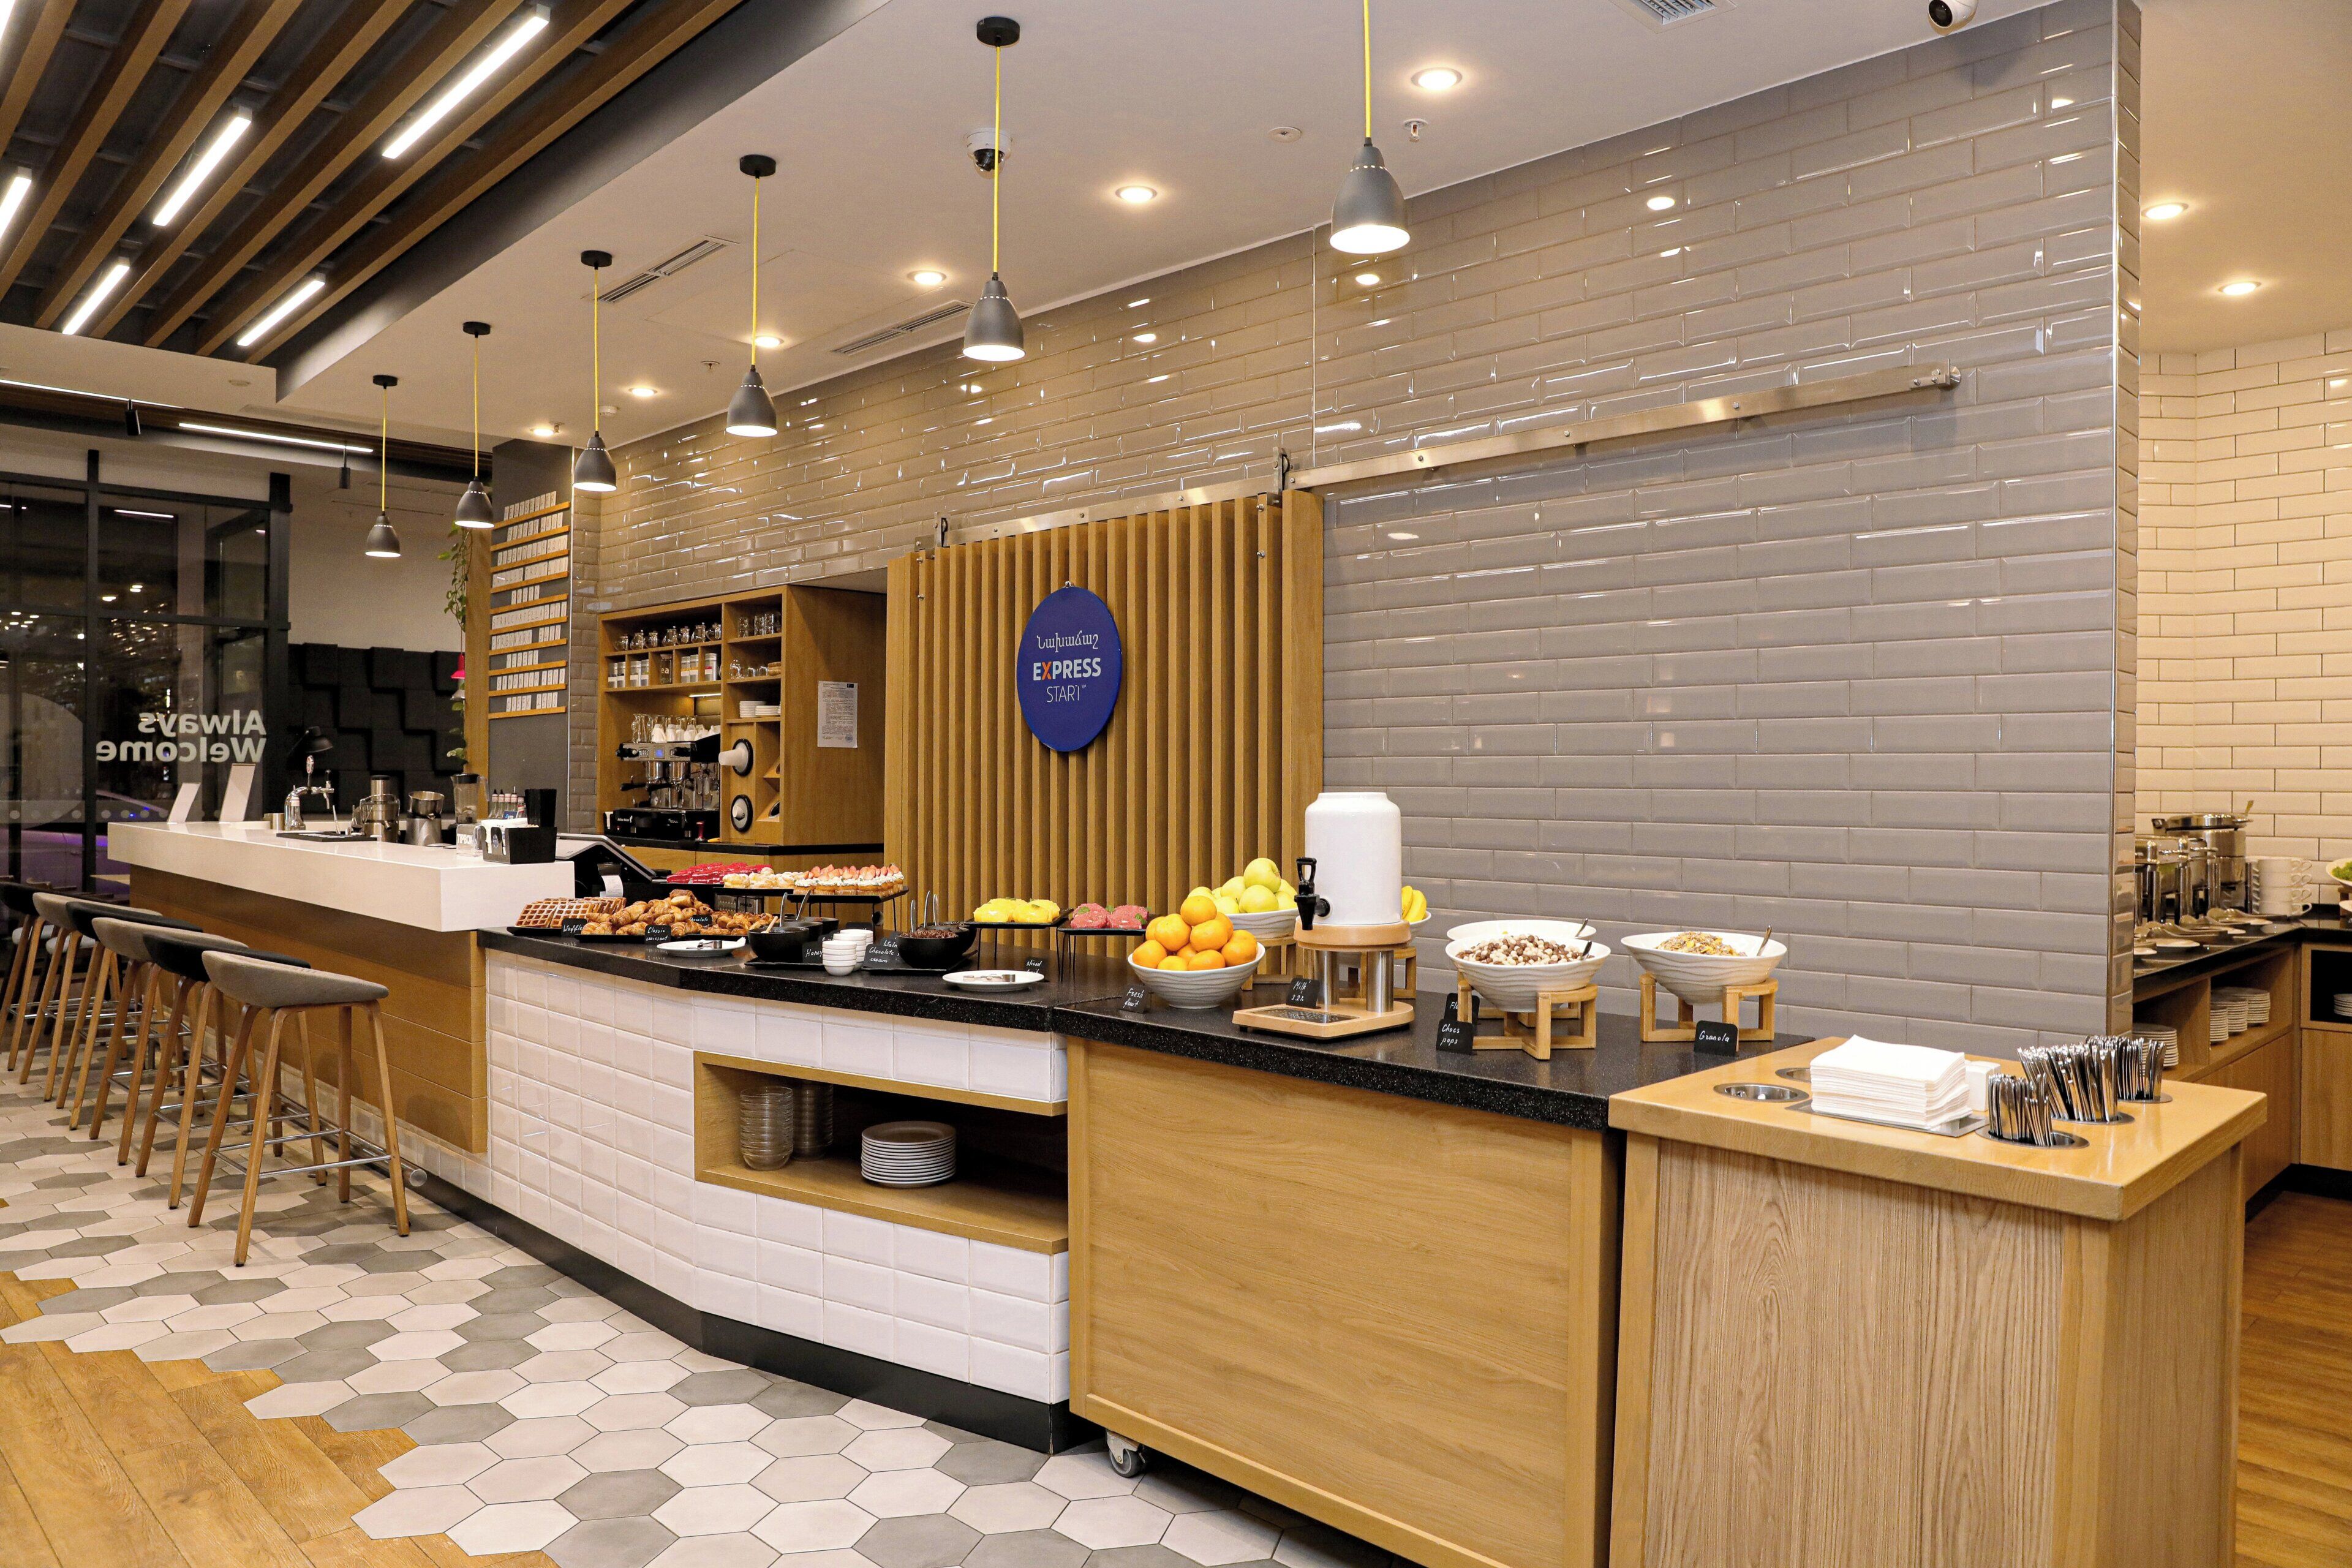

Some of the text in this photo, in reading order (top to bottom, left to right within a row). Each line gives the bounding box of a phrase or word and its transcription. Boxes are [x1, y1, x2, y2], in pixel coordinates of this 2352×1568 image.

[1037, 630, 1098, 652] Նախաճաշ
[1033, 657, 1101, 680] EXPRESS
[1047, 685, 1080, 703] START
[805, 948, 823, 957] Honey
[869, 947, 894, 956] Chocolate
[1293, 981, 1307, 990] Milk
[1126, 988, 1144, 998] Fresh
[1442, 1023, 1460, 1034] Chocs
[1698, 1030, 1730, 1042] Granola
[1440, 1038, 1458, 1046] pops
